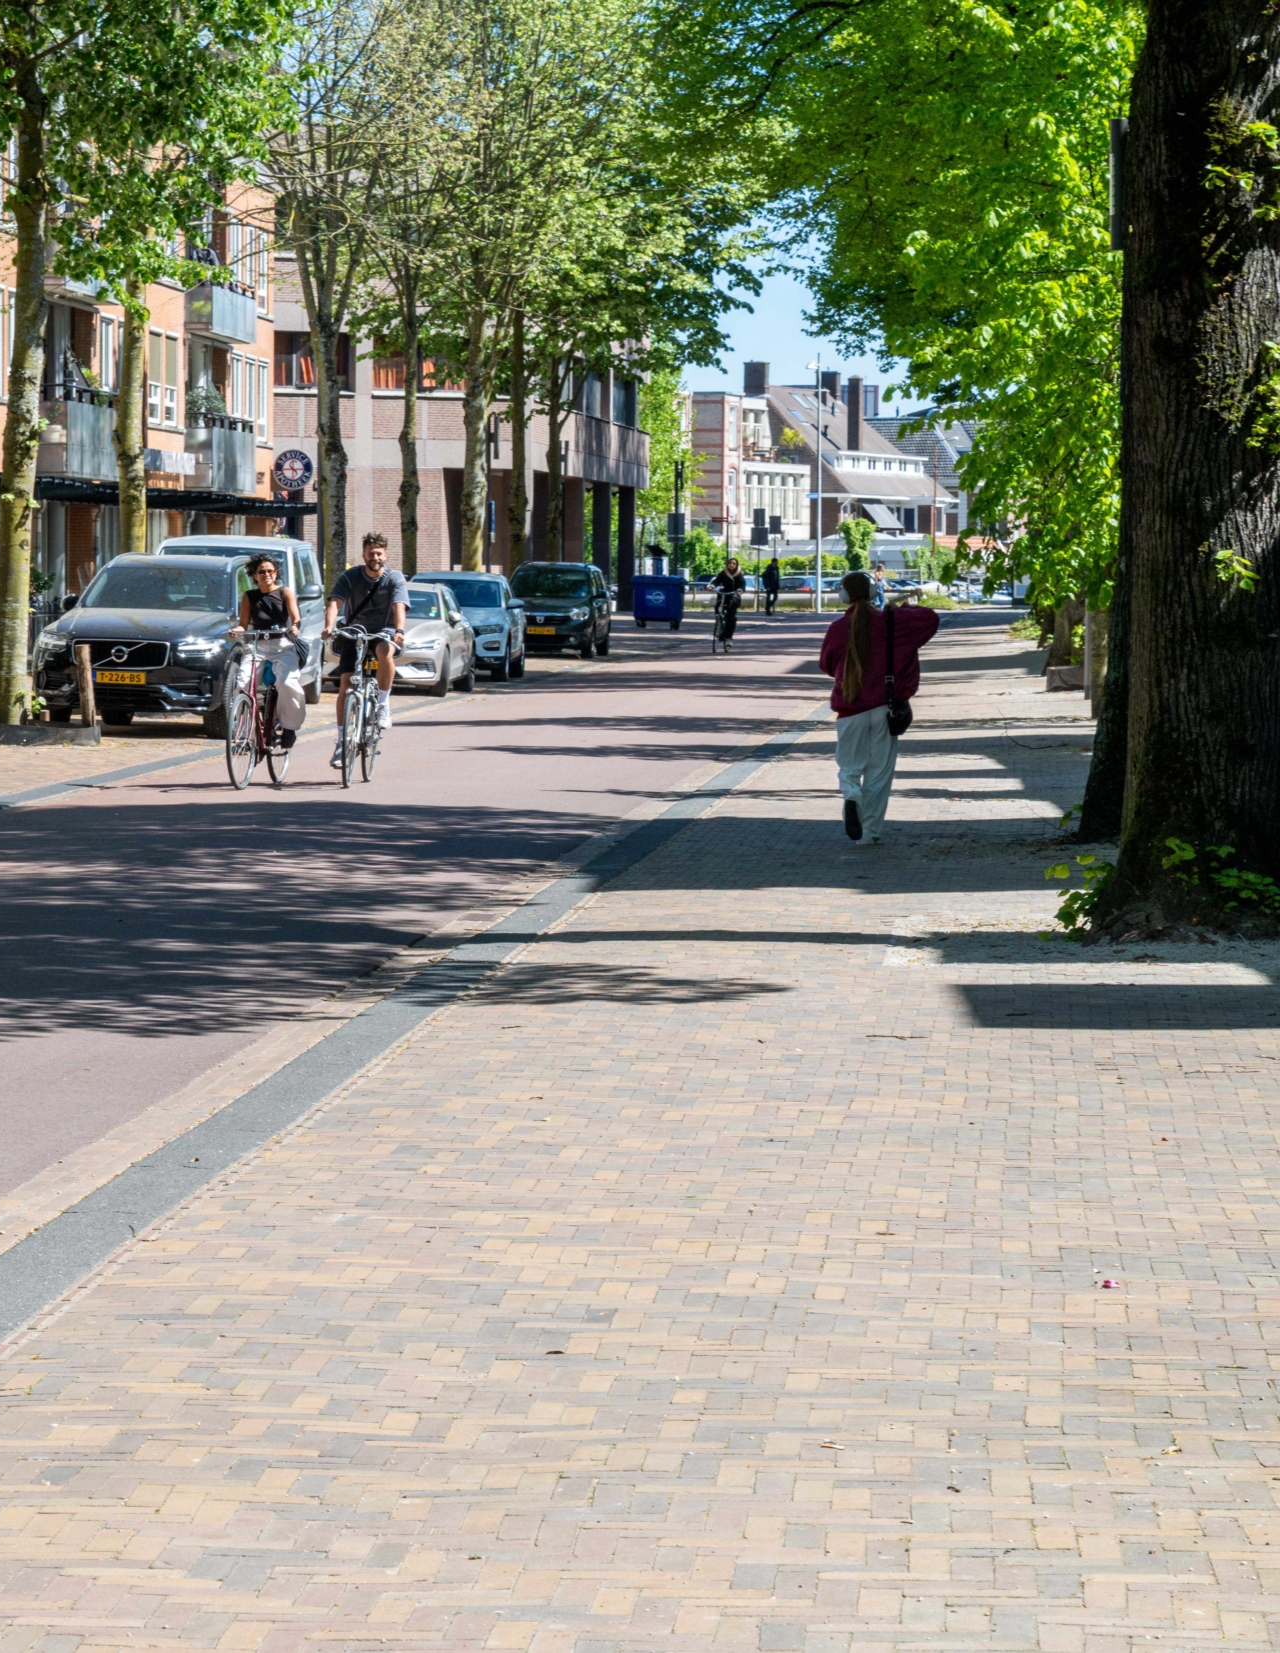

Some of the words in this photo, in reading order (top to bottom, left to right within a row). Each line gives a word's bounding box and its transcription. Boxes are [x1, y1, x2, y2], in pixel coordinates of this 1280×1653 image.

[277, 451, 310, 466] SERVICE
[275, 470, 311, 488] APOTHEEK
[99, 672, 142, 683] T-226-BS
